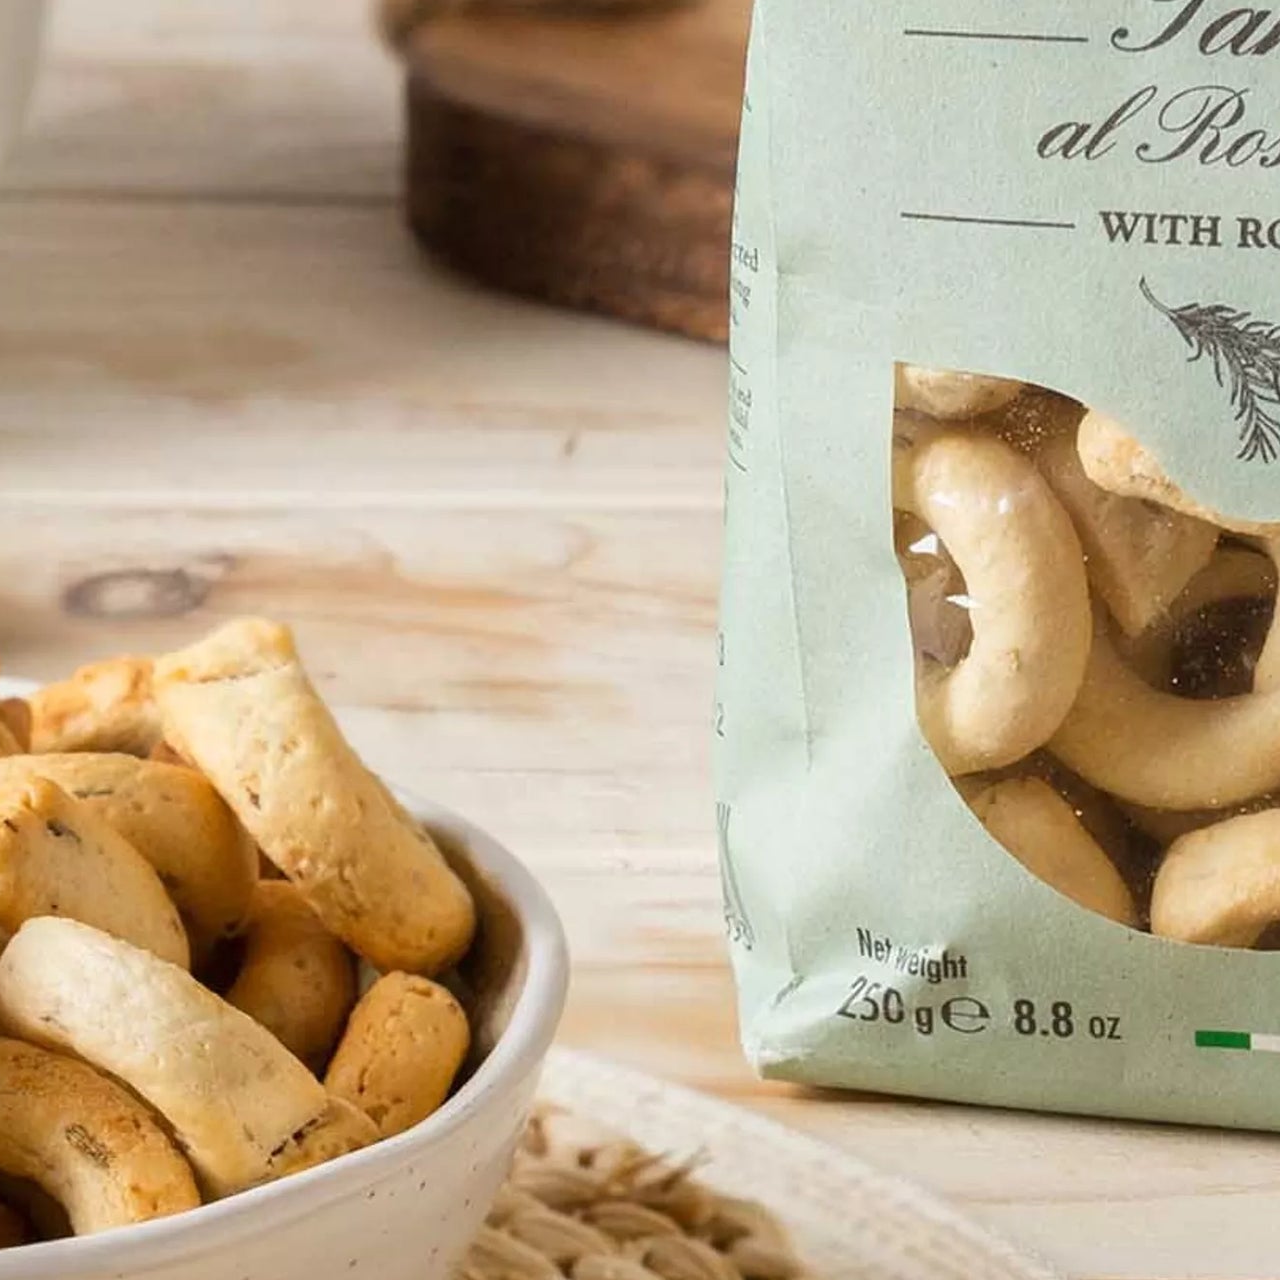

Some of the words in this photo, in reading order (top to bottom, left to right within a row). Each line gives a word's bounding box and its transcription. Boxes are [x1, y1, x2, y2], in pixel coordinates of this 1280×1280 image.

[1035, 84, 1159, 163] al
[1098, 209, 1222, 249] WITH
[856, 926, 893, 963] Net
[894, 946, 968, 985] weight
[837, 975, 906, 1024] 250
[1013, 999, 1074, 1039] 8.8
[1089, 1016, 1123, 1040] oz
